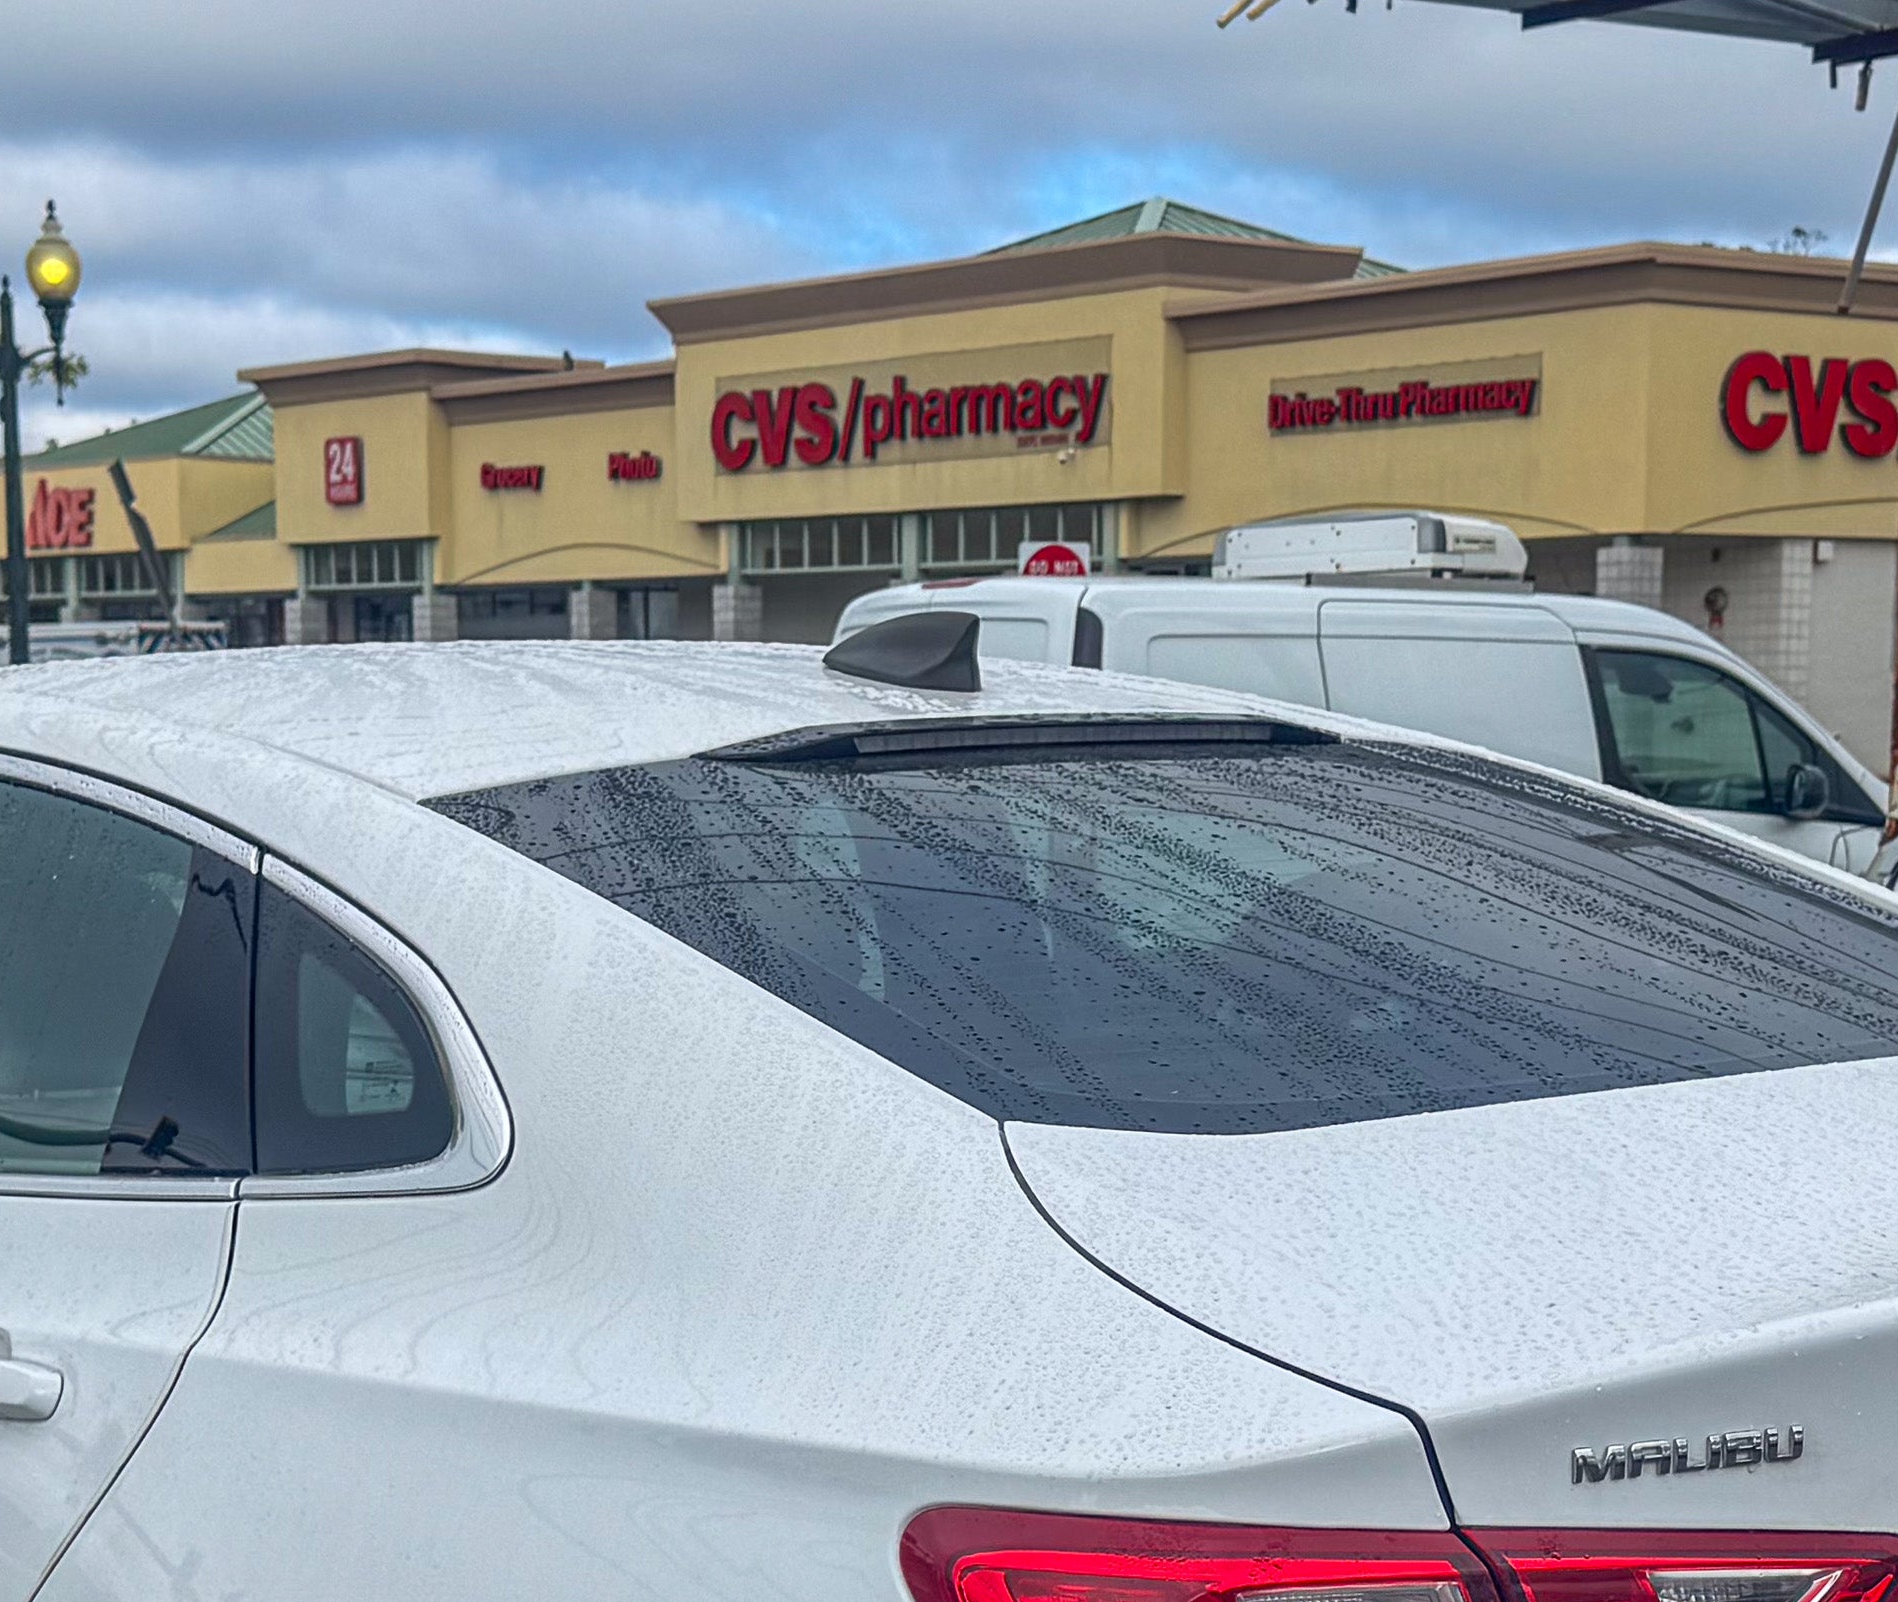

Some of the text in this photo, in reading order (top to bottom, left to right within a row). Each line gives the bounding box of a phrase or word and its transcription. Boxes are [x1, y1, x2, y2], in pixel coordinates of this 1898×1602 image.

[711, 374, 1108, 471] CVS/pharmacy
[1268, 380, 1537, 430] Drive-Thru Pharmacy
[328, 442, 355, 484] 24
[608, 451, 663, 482] Photo
[26, 478, 95, 549] ACE
[1570, 1423, 1805, 1485] MALIBU
